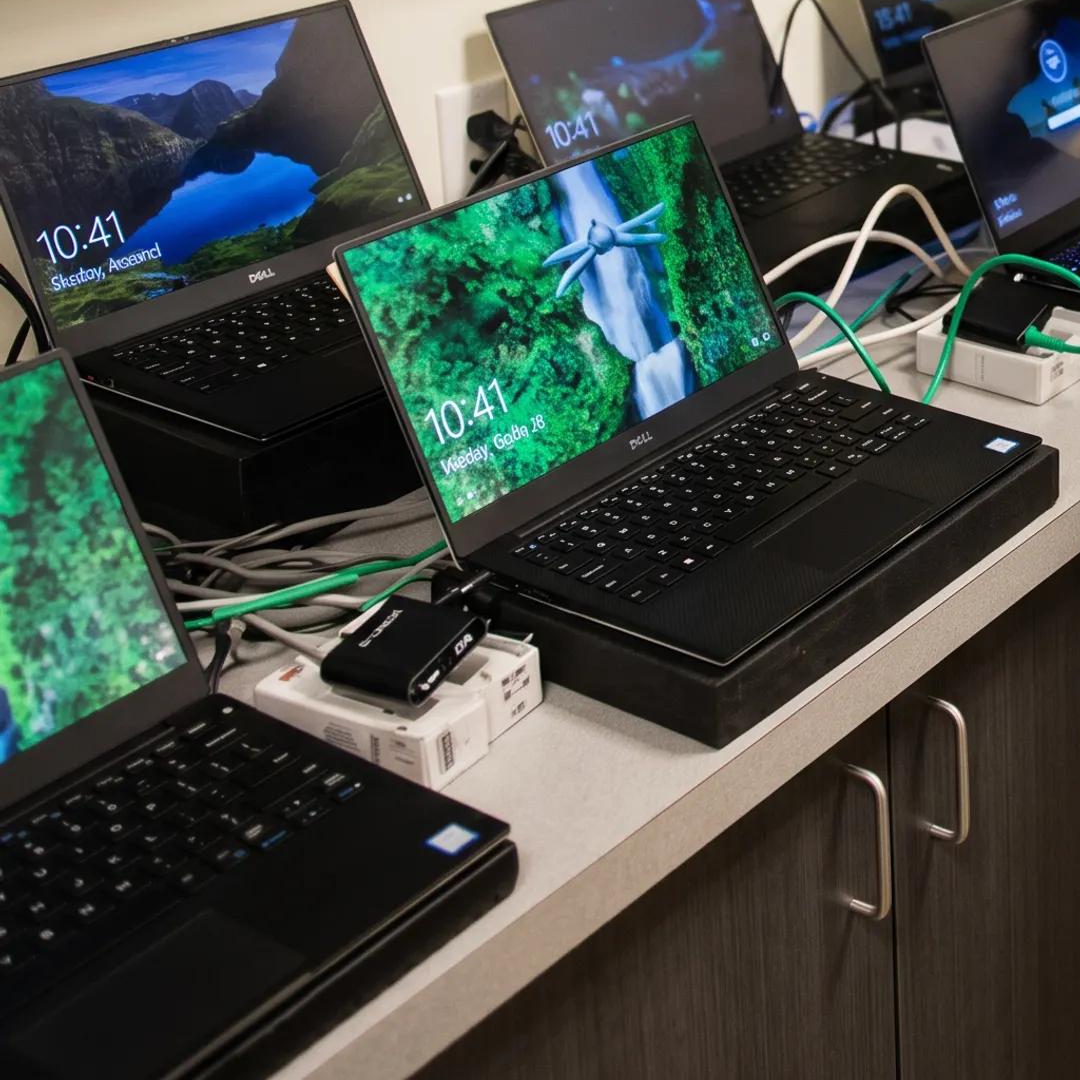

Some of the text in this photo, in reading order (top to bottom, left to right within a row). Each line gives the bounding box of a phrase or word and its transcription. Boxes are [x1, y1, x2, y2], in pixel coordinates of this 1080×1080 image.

[545, 111, 600, 149] 10:41
[36, 210, 125, 264] 10:41
[424, 378, 508, 445] 10:41
